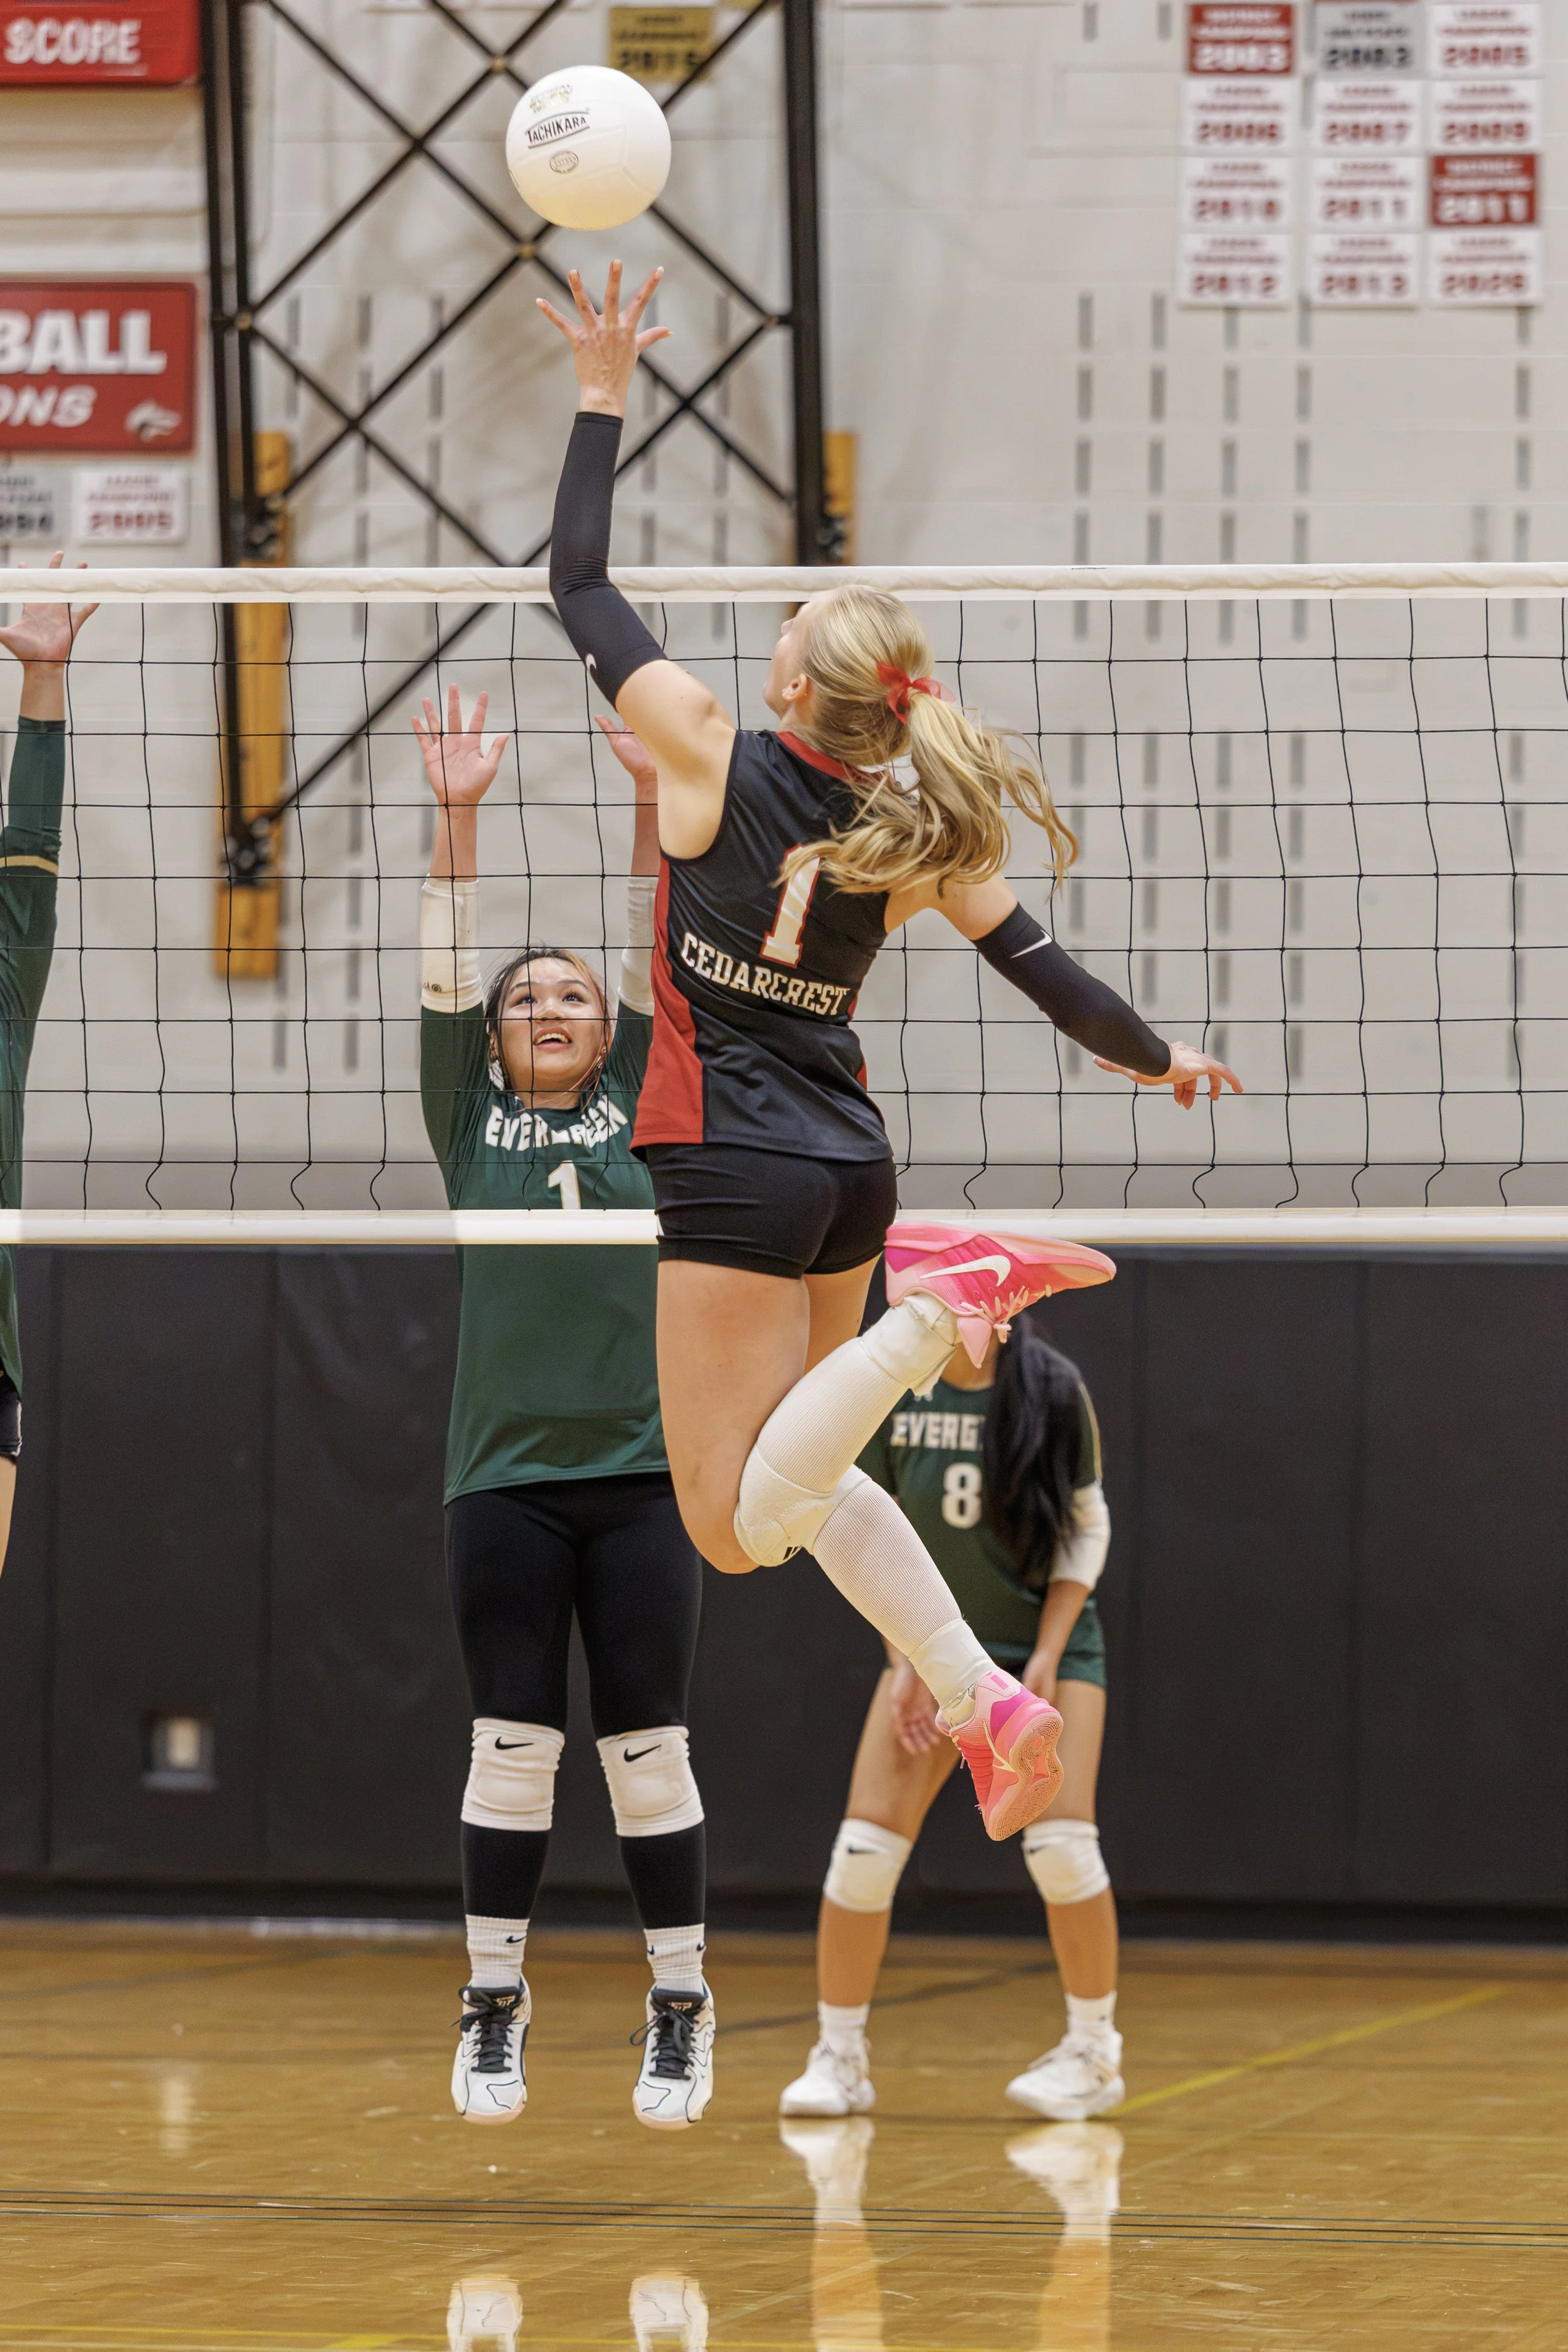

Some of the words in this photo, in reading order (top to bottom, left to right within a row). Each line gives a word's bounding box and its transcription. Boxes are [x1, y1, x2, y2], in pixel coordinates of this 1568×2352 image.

[4, 17, 141, 65] SCORE
[527, 115, 587, 144] TACHIKARA
[0, 309, 167, 374] BALL
[760, 844, 822, 968] 1
[681, 932, 850, 1016] CEDARCREST
[548, 1160, 581, 1209] 1
[890, 1412, 986, 1452] EVERG
[942, 1462, 983, 1528] 8
